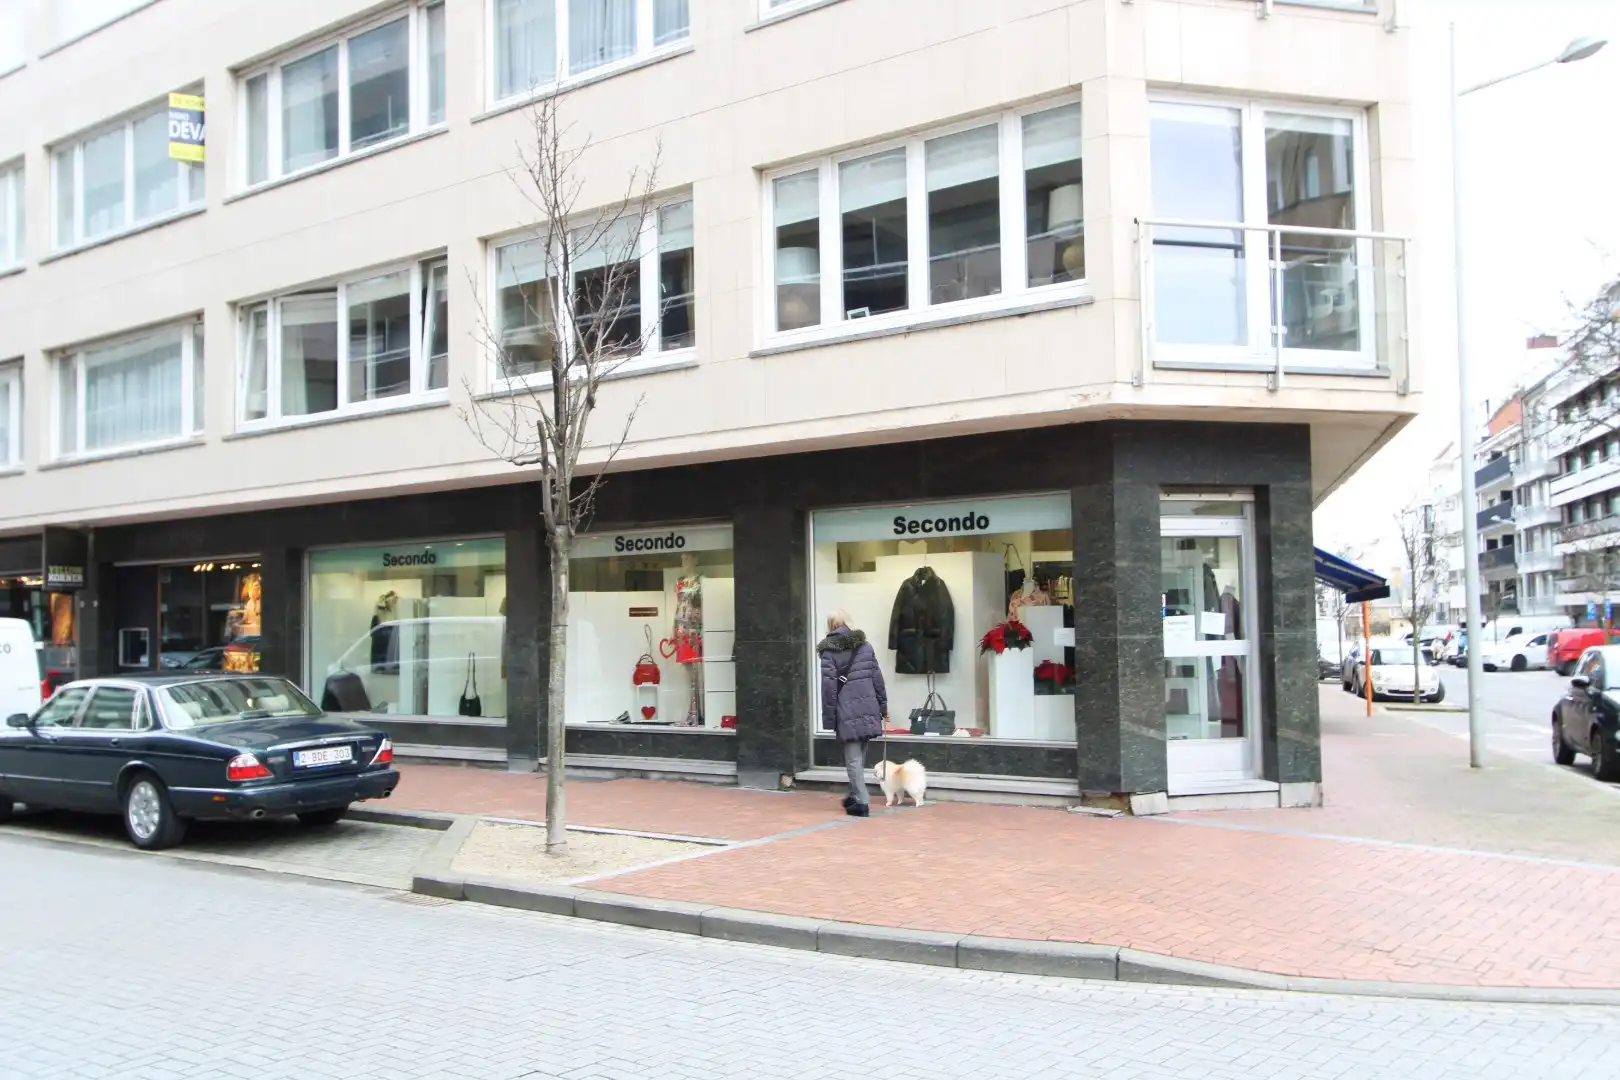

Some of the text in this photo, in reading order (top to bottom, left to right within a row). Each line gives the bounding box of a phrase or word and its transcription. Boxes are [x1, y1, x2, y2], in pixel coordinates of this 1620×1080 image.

[893, 511, 990, 535] Secondo
[614, 531, 686, 552] Secondo
[382, 550, 437, 567] Secondo
